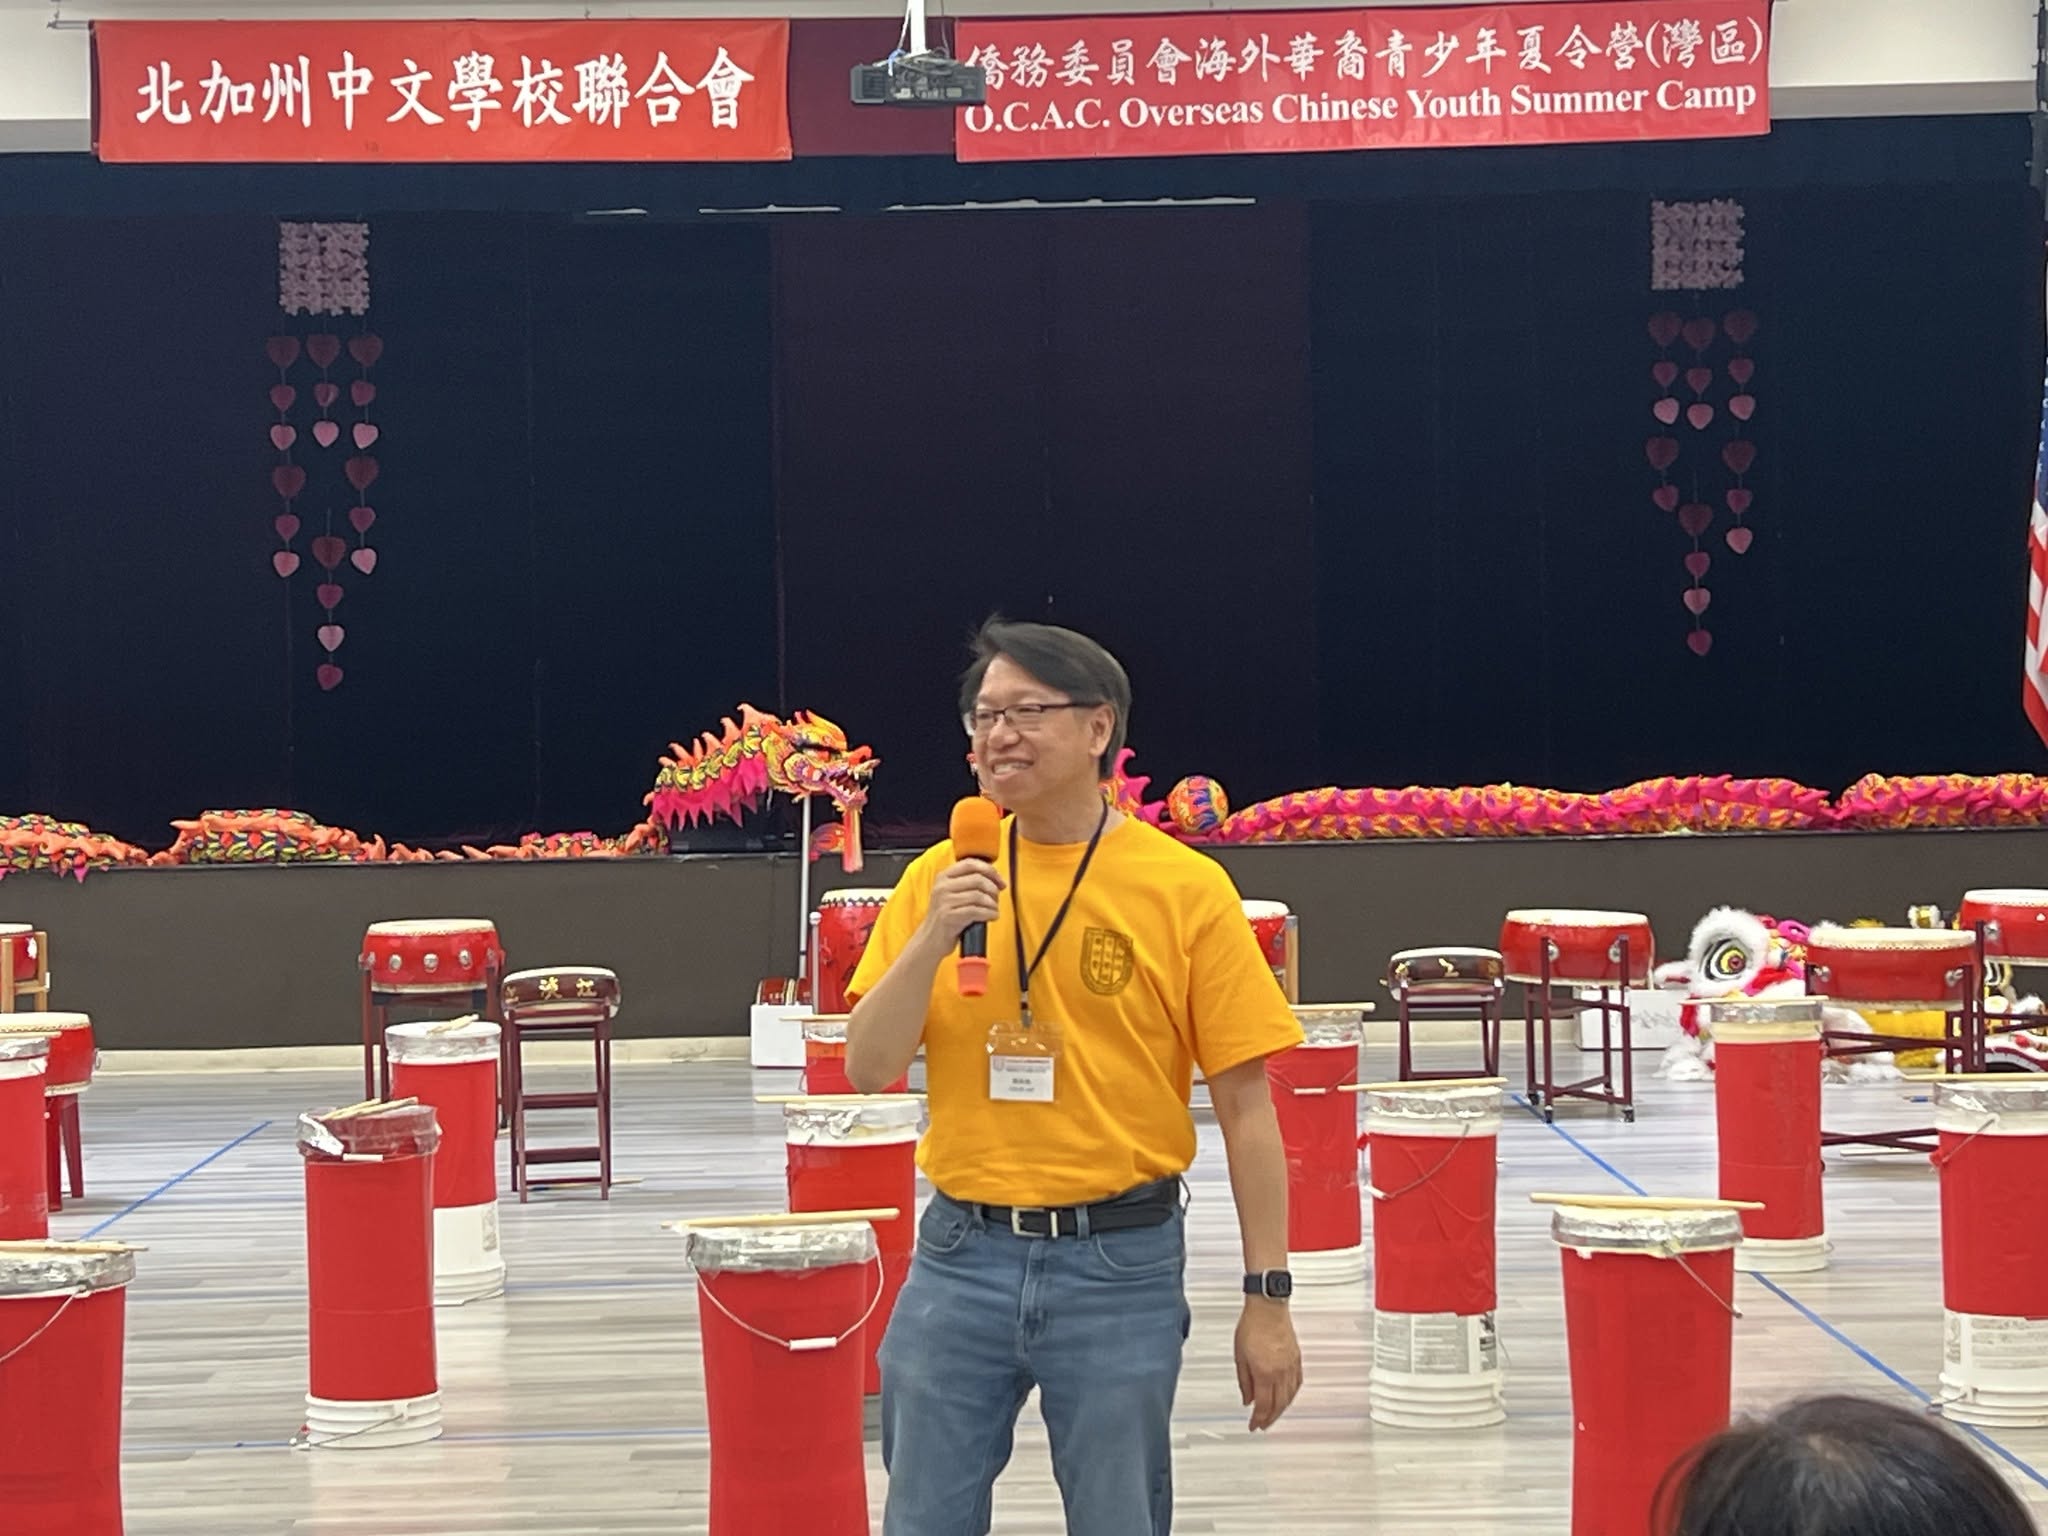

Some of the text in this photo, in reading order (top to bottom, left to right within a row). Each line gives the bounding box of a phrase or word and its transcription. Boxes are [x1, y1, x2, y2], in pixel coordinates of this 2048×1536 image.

[135, 46, 755, 132] 北加州中文學校聯合會
[963, 79, 1757, 134] O.C.A.C. Overseas Chinese Youth Summer Camp
